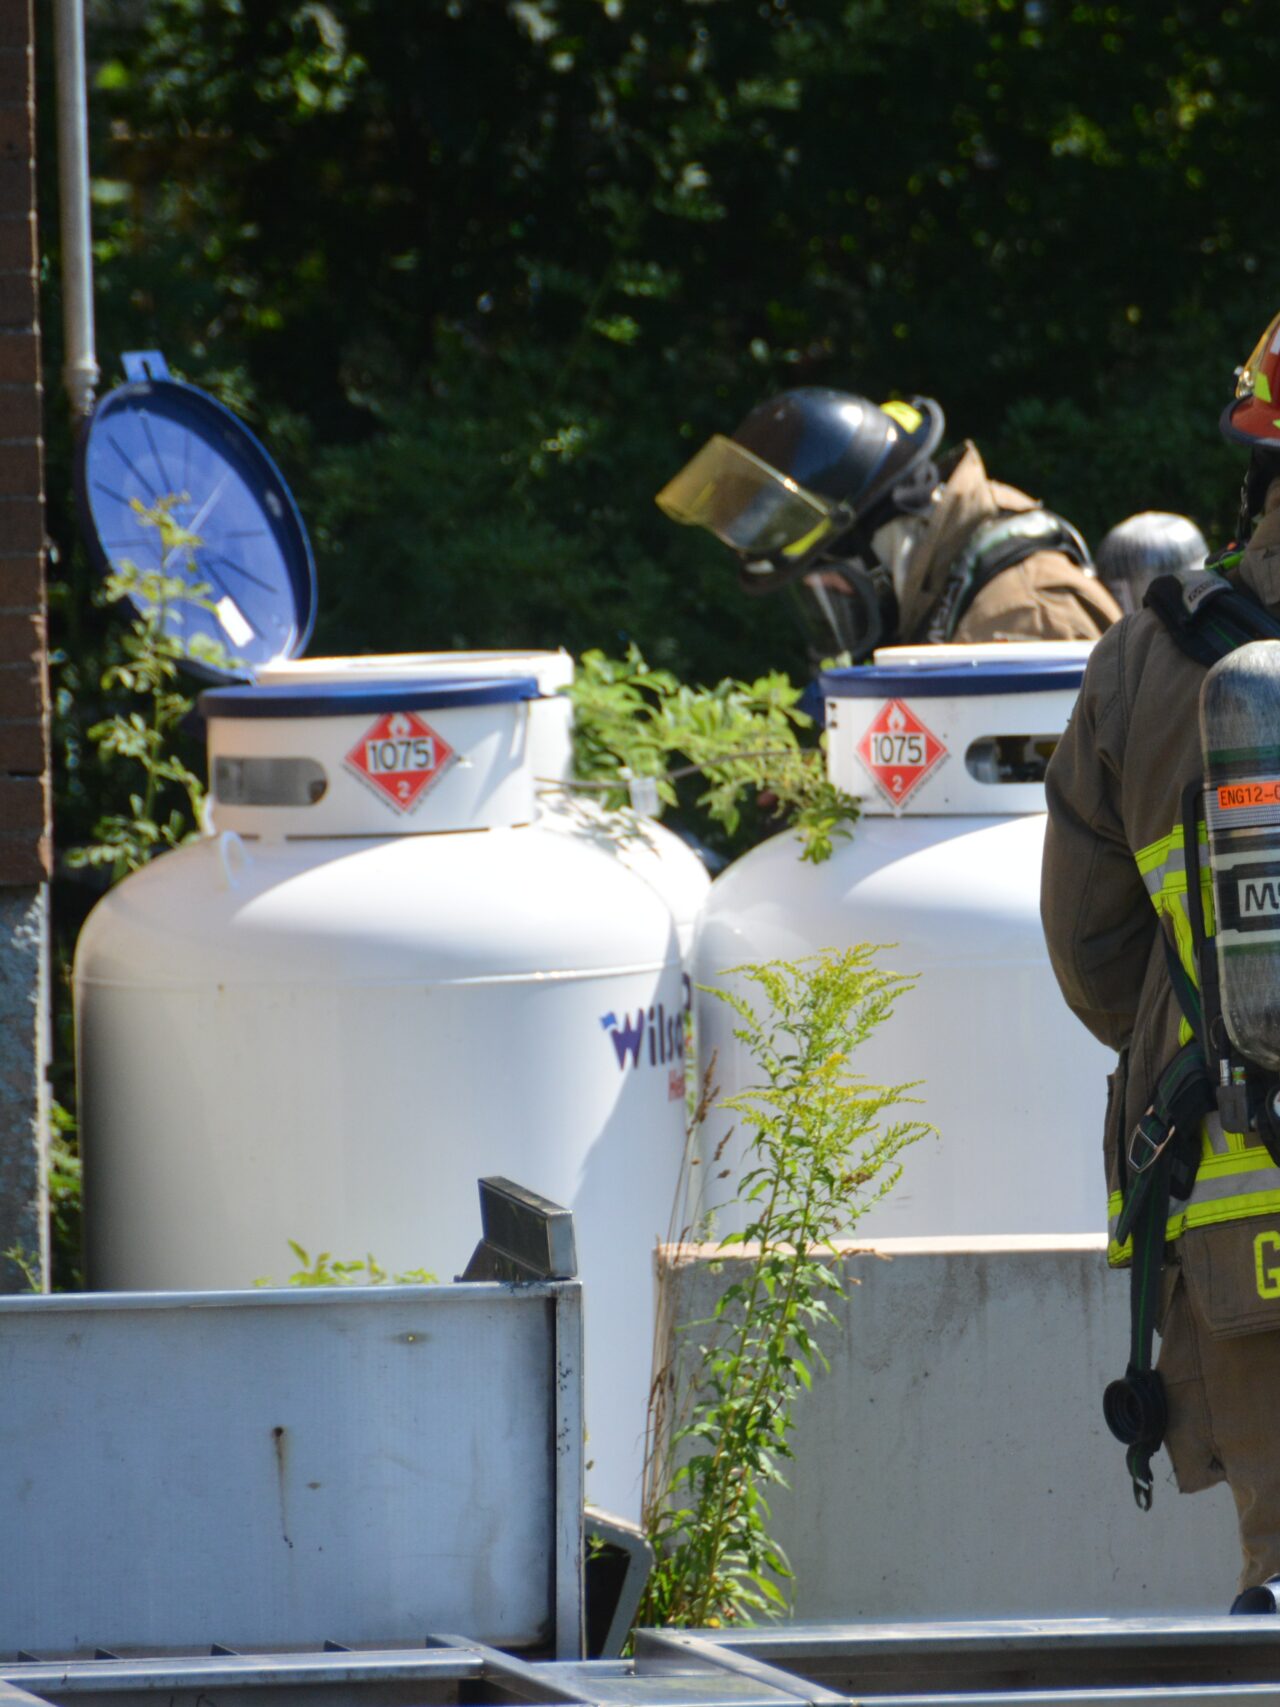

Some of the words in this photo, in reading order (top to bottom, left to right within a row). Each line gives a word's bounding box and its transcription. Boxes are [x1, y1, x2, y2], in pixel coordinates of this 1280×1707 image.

[370, 739, 430, 771] 1075
[872, 734, 923, 764] 1075
[397, 780, 411, 799] 2
[892, 774, 904, 793] 2
